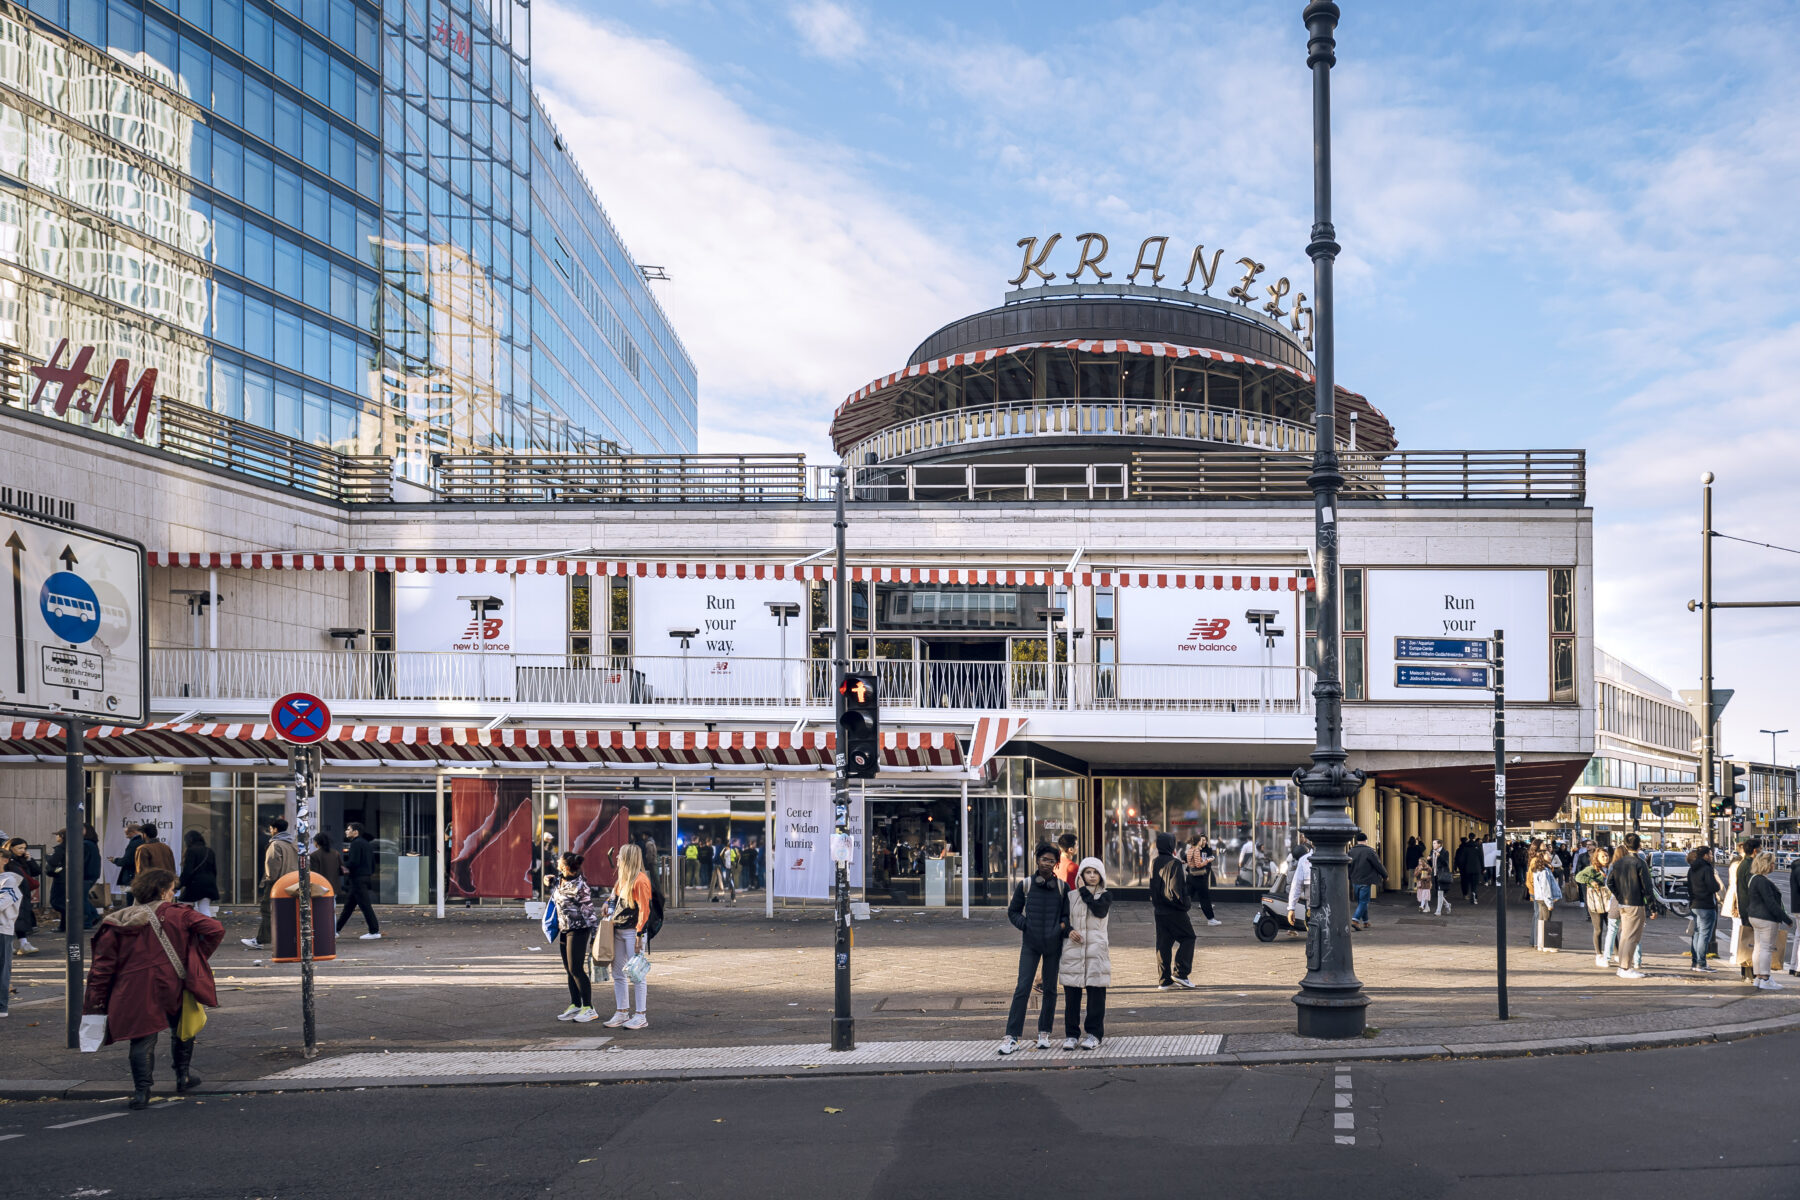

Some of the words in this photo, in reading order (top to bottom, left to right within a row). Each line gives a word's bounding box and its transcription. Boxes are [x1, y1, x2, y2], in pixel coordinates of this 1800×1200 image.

[435, 18, 470, 62] H&M
[29, 337, 159, 439] H&M
[706, 594, 736, 610] Run
[1444, 594, 1475, 610] Run
[705, 619, 737, 635] your
[1443, 619, 1477, 636] your
[453, 643, 471, 651] new
[472, 642, 510, 651] blance
[706, 641, 735, 656] way.
[1198, 642, 1238, 652] balance
[45, 665, 101, 679] Krankenfahrzeuge
[62, 676, 76, 685] TAXI
[78, 677, 89, 687] frei
